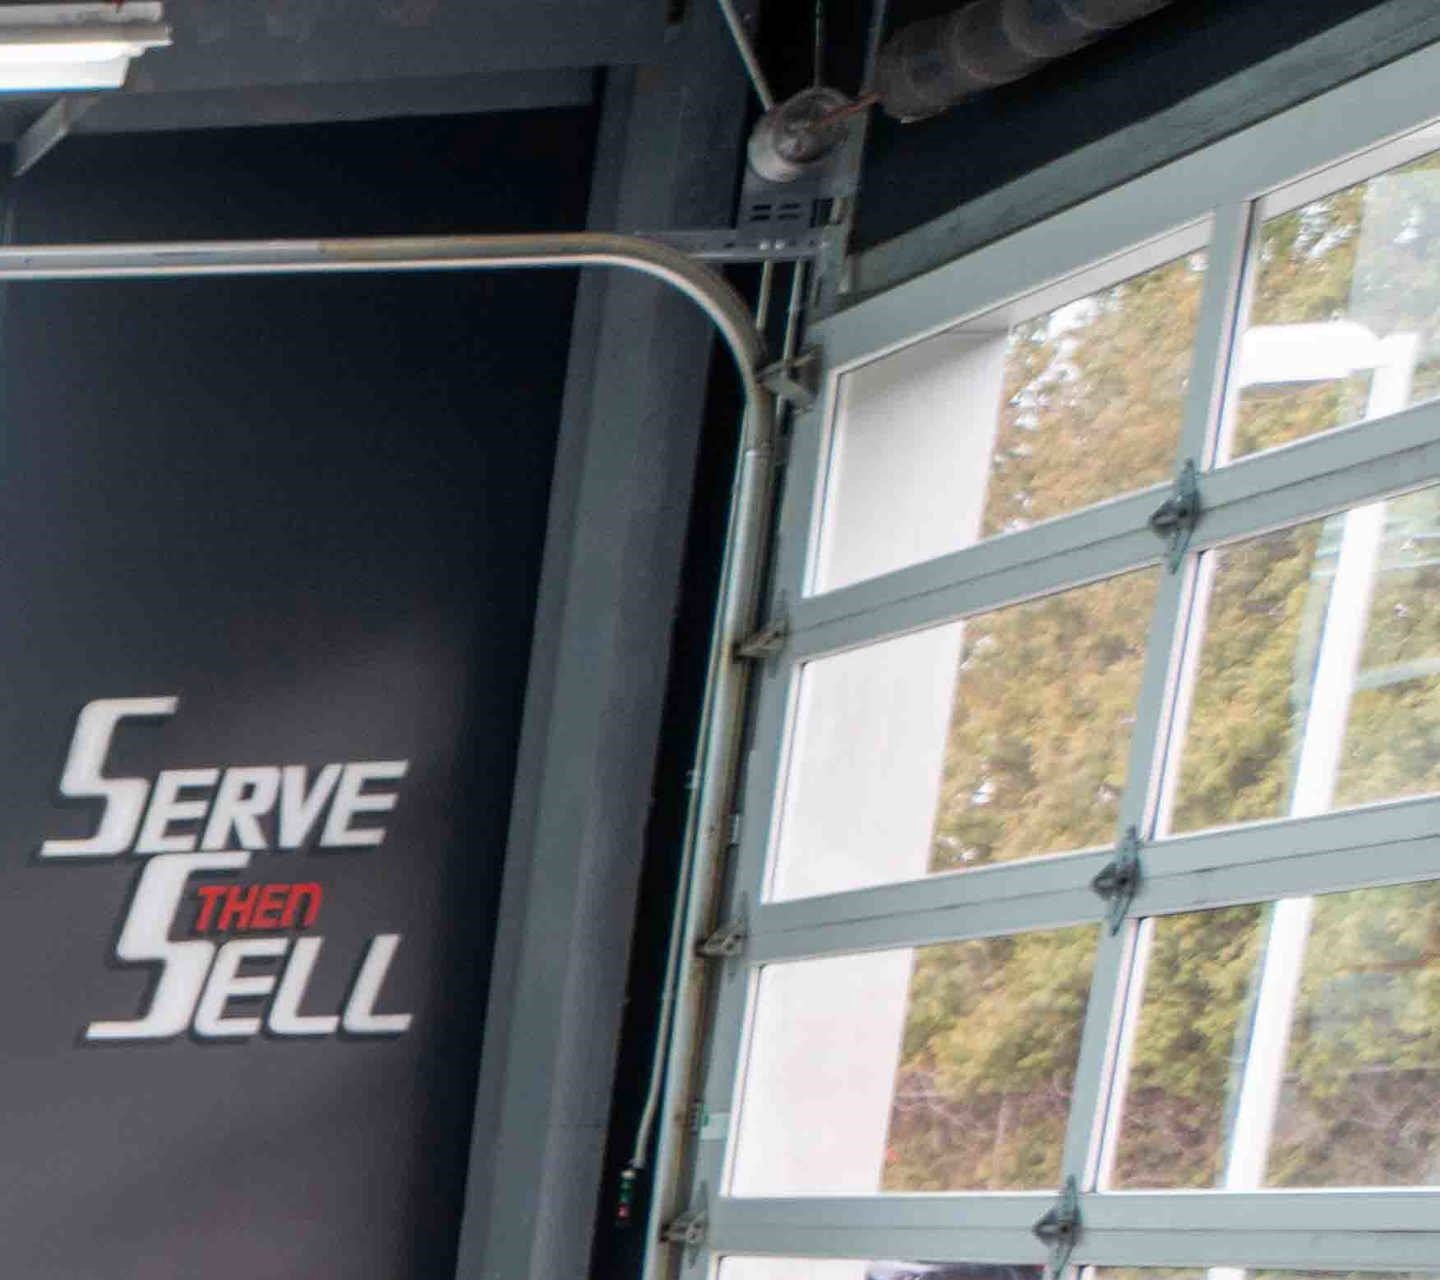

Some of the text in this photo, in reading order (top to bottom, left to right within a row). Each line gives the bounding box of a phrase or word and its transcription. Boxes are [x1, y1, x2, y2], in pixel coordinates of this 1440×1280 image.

[40, 696, 409, 857] SERVE
[85, 851, 413, 1041] SELL
[194, 881, 322, 932] THEN
